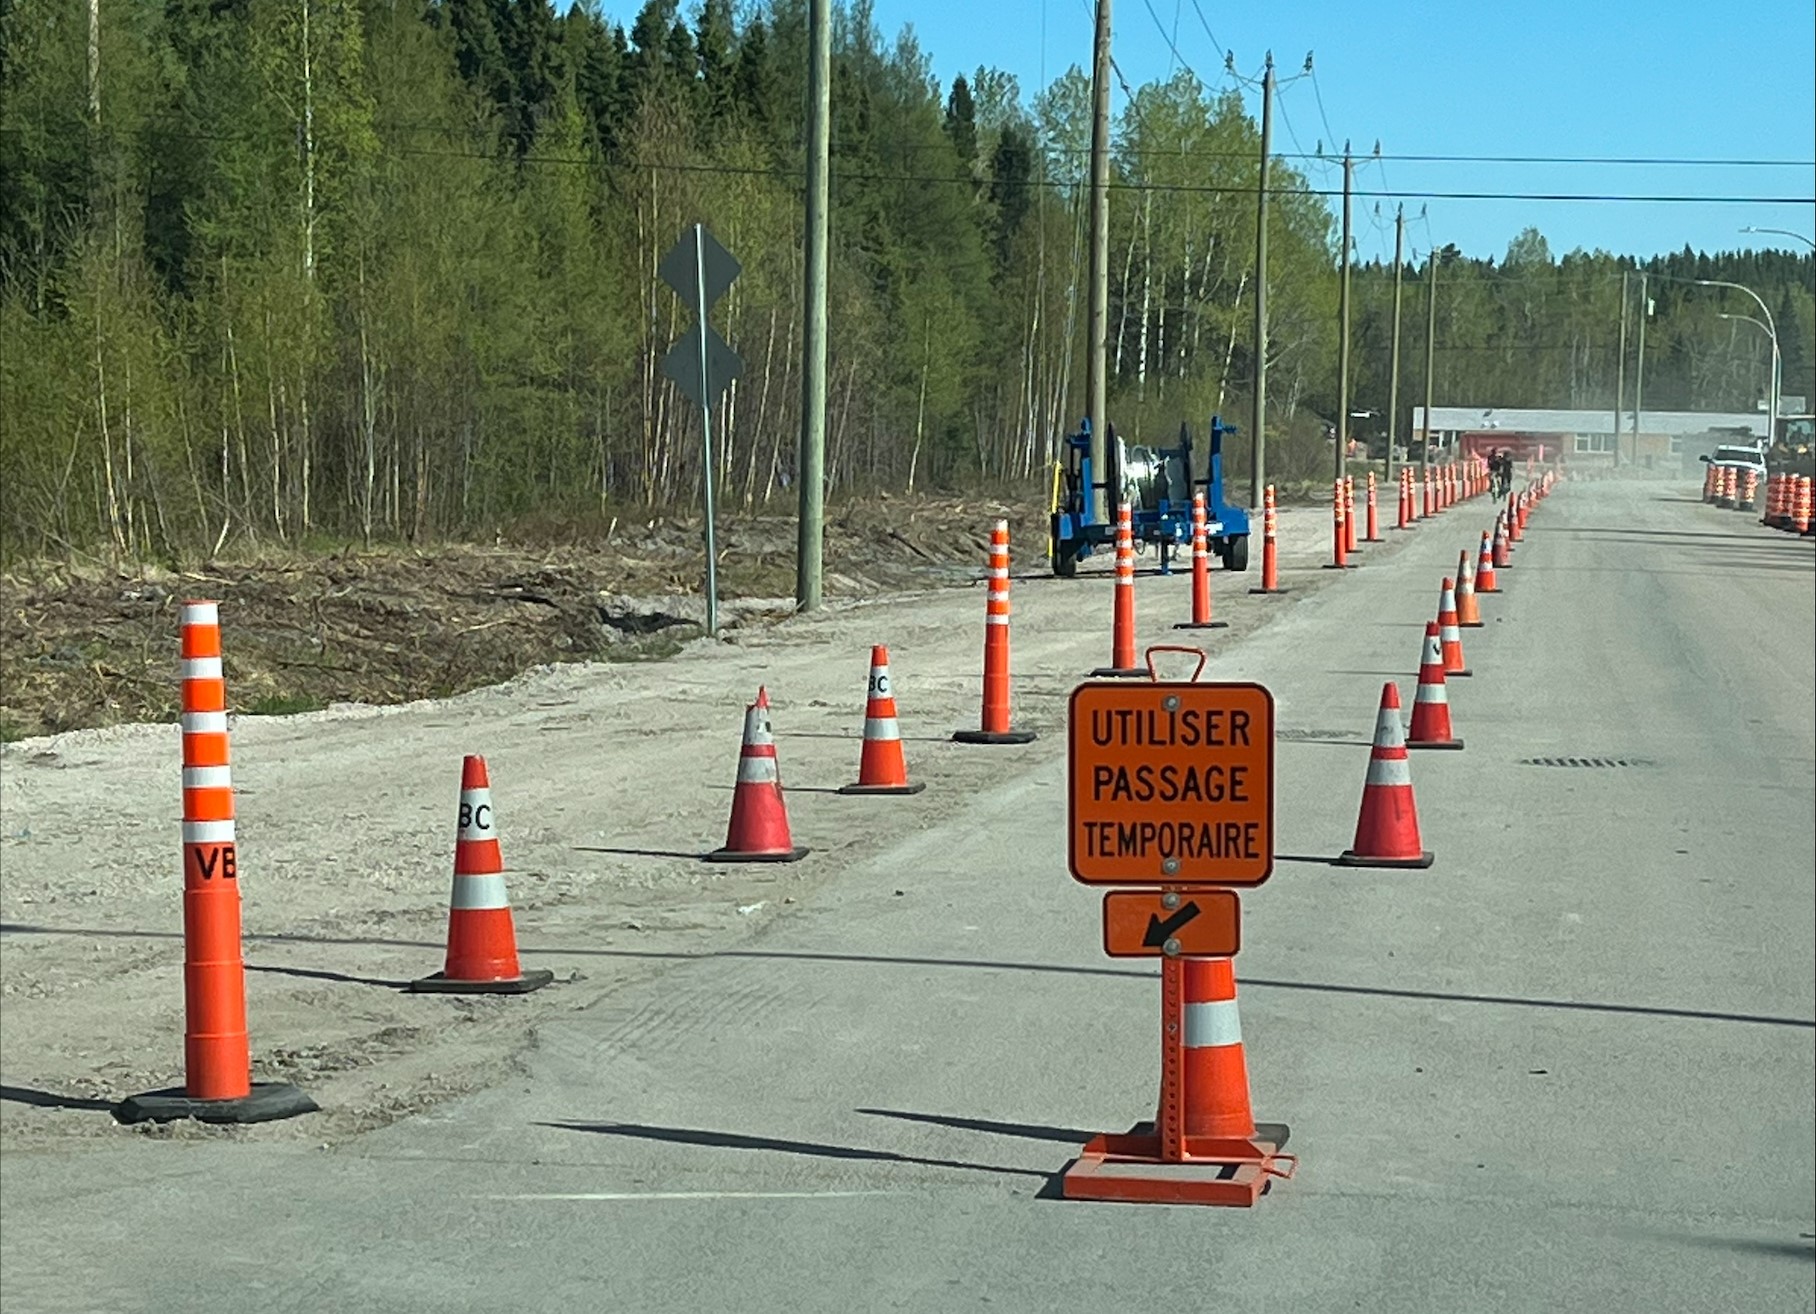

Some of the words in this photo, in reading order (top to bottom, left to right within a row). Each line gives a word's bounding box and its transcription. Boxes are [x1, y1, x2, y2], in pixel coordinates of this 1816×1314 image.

[1092, 710, 1251, 746] UTILISER
[1094, 765, 1249, 802] PASSAGE
[460, 802, 491, 830] BC
[1084, 822, 1260, 859] TEMPORAIRE
